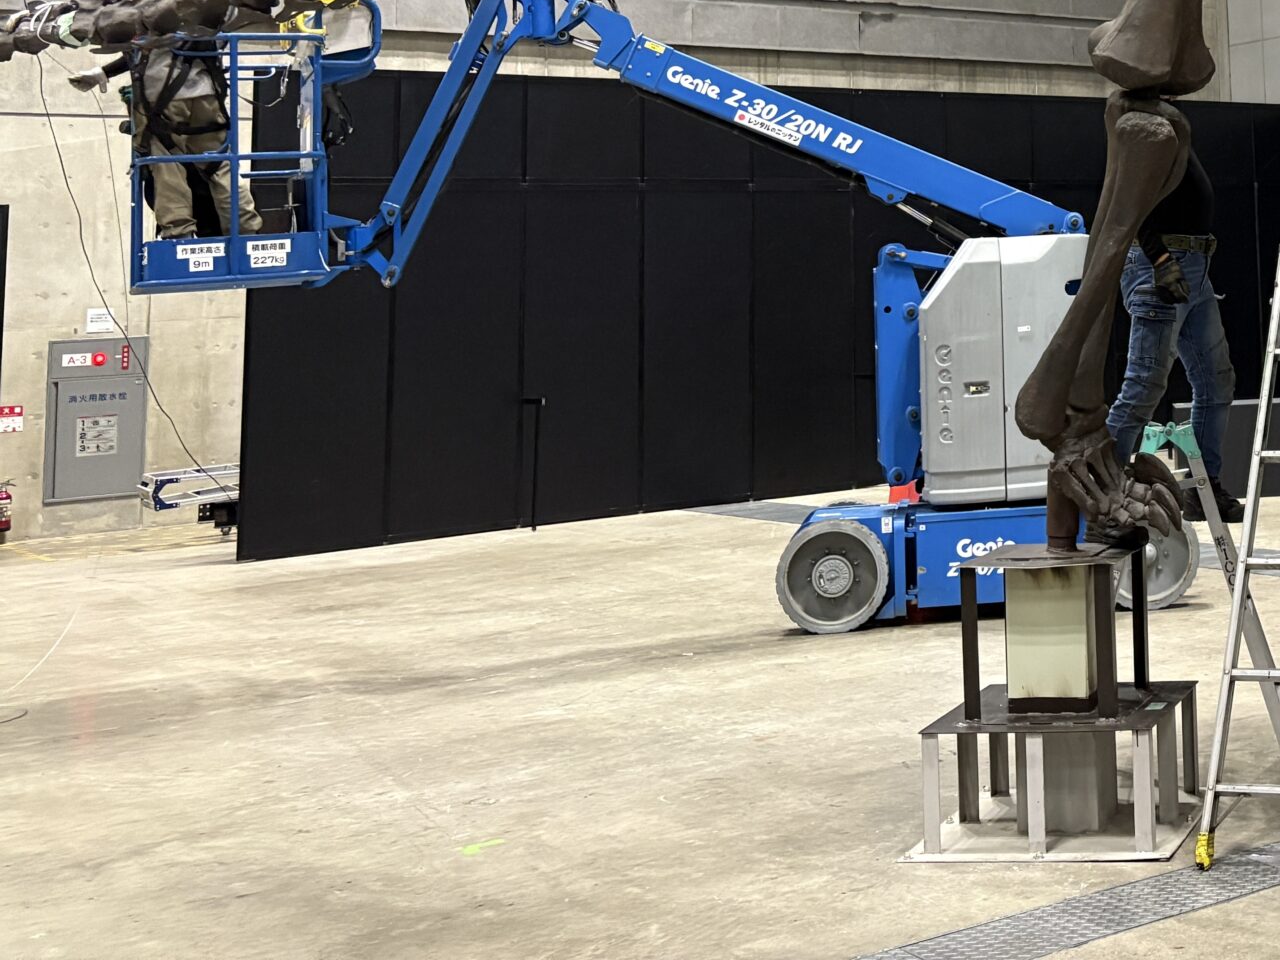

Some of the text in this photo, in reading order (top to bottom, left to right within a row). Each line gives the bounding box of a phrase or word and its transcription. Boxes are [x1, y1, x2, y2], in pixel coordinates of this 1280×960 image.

[666, 65, 864, 154] Genie Z-30/20N RJ
[747, 117, 800, 142] レンタルのニッケン
[181, 246, 222, 256] 作業床高さ
[193, 260, 210, 269] 9m
[253, 255, 285, 265] 227kg
[67, 355, 87, 365] A-3
